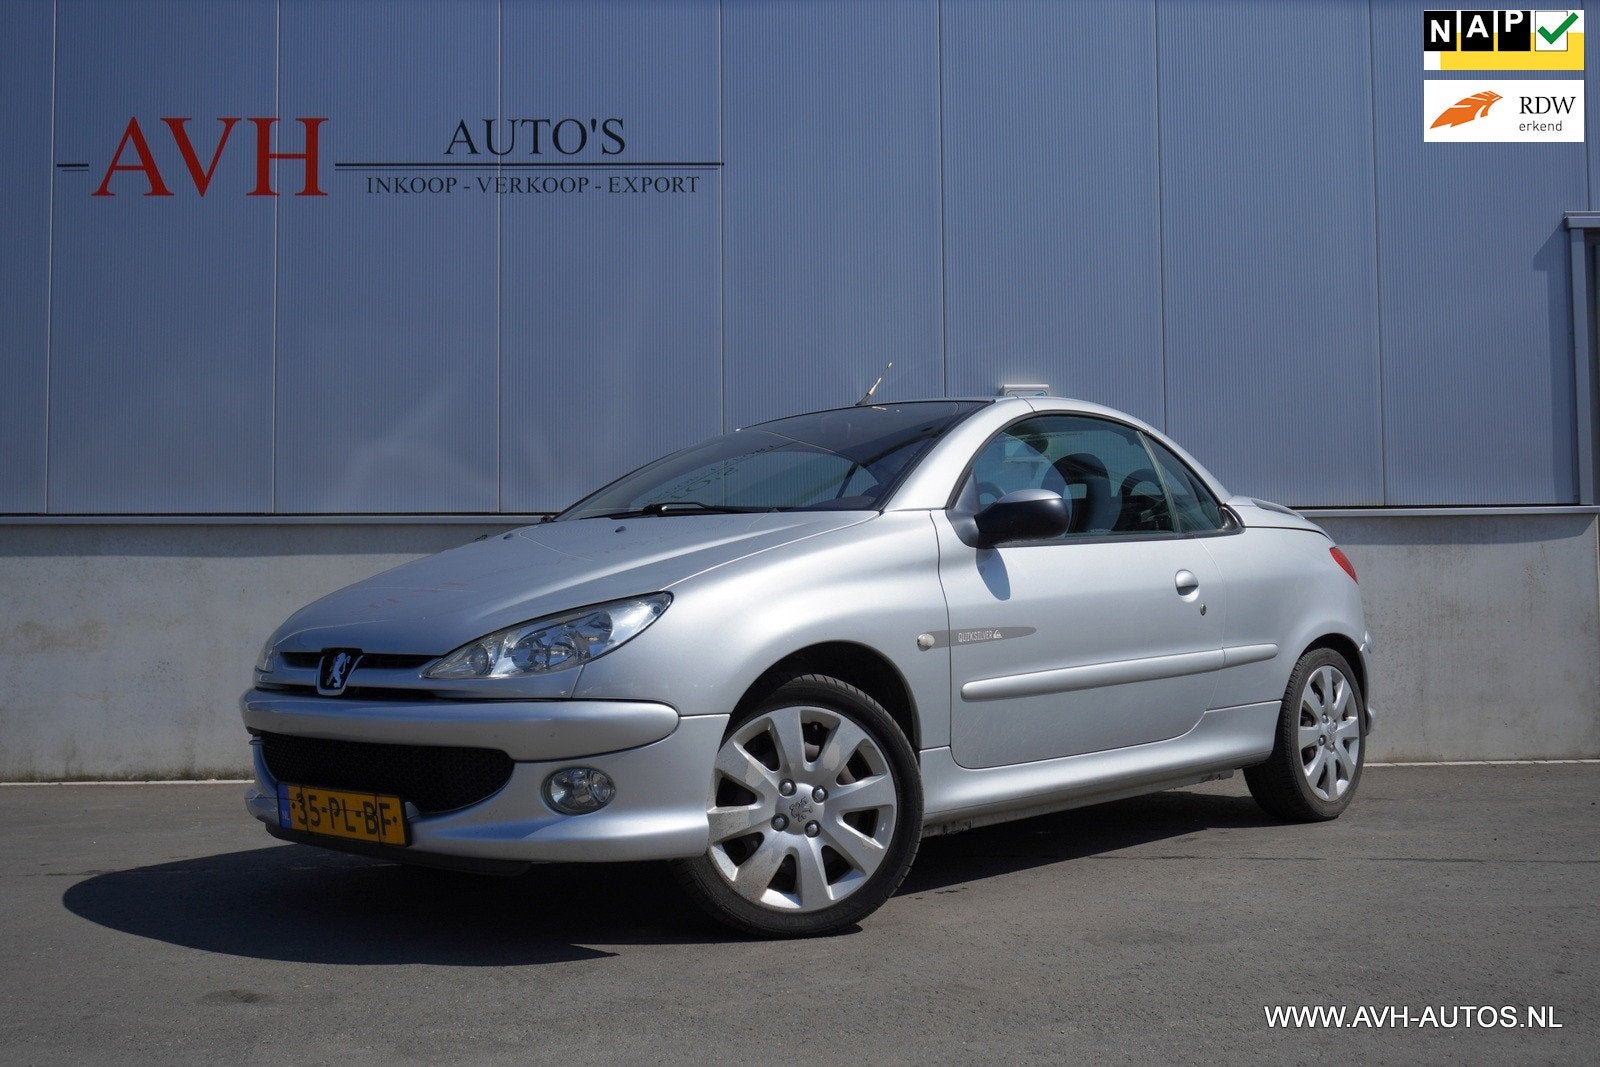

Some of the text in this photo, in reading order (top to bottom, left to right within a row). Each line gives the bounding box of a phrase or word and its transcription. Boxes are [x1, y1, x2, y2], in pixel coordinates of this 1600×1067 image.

[443, 118, 626, 155] AUTO'S
[91, 117, 329, 197] AVH
[367, 176, 457, 193] INKOOP
[477, 176, 589, 194] VERKOOP
[609, 176, 700, 193] EXPORT
